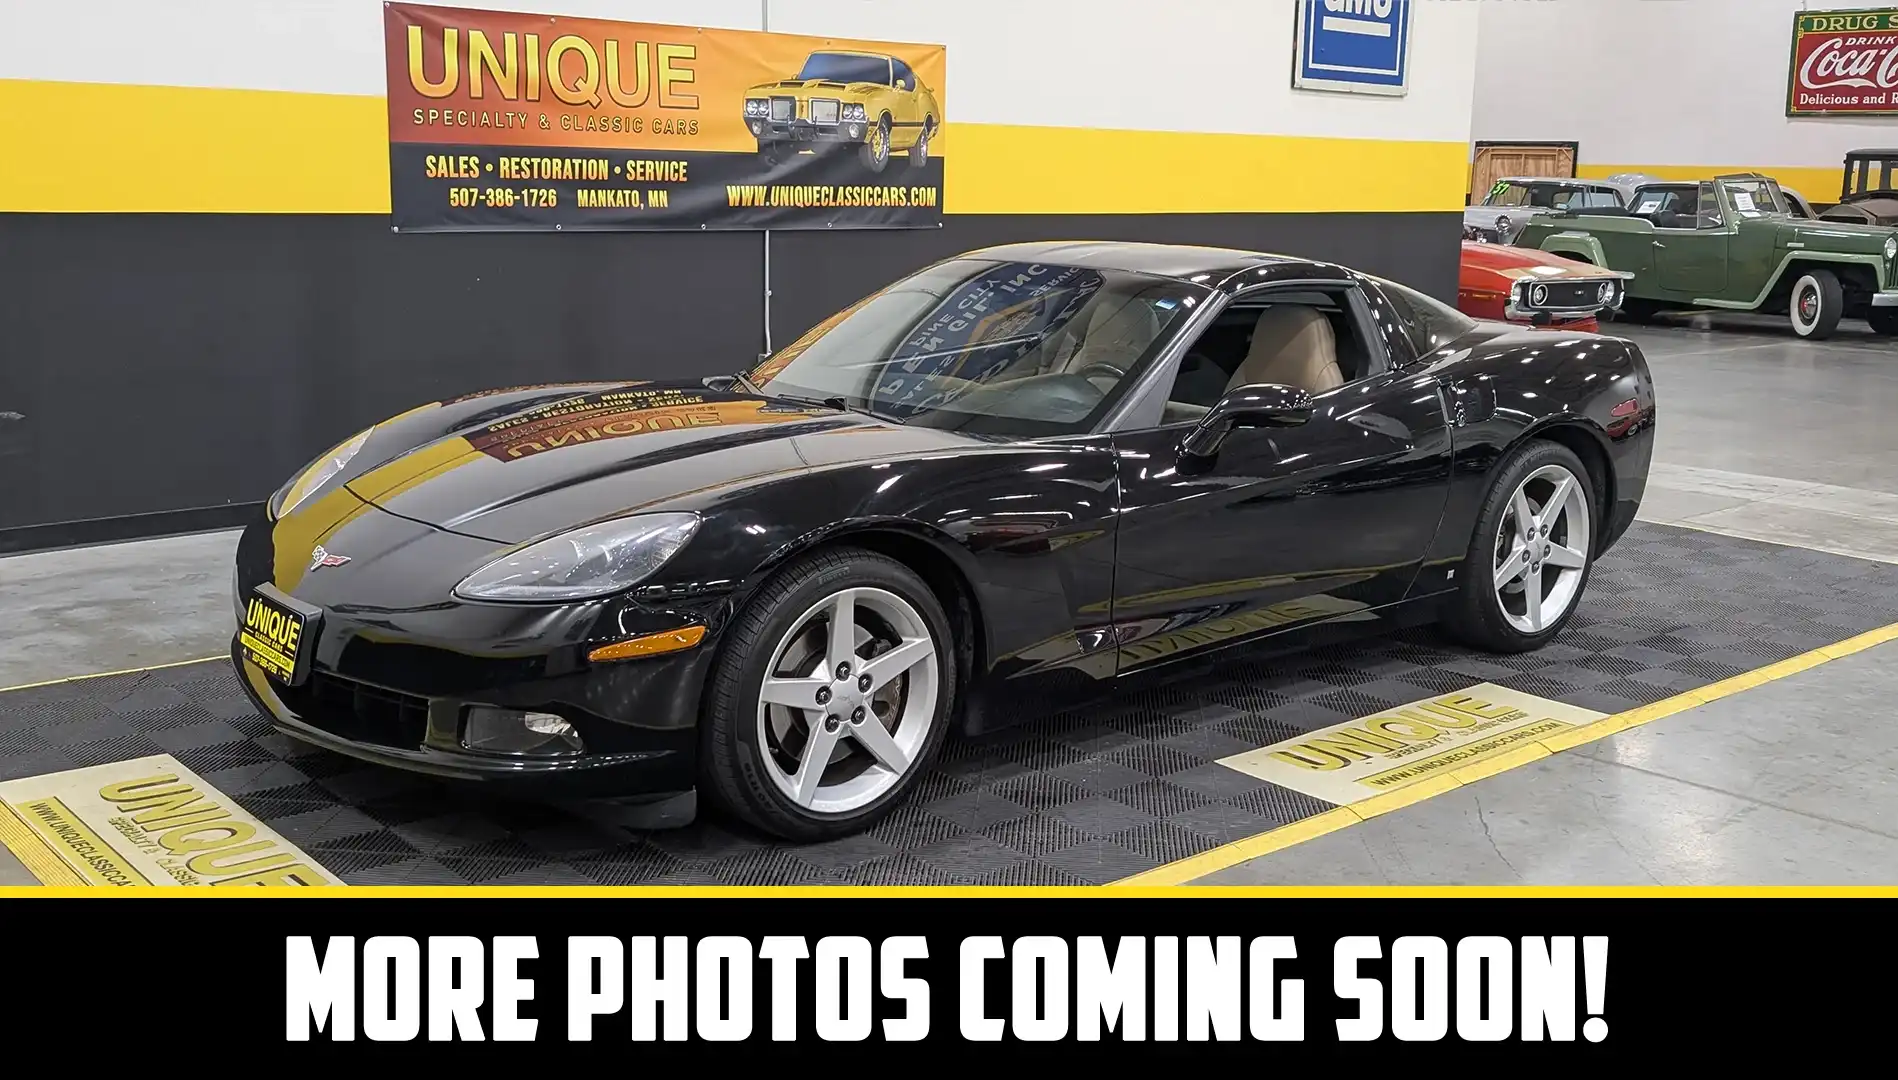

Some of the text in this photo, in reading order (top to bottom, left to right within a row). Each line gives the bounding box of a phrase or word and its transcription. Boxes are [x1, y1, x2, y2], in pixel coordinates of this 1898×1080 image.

[1812, 15, 1878, 31] DRUG
[1845, 36, 1897, 46] DRINK
[407, 24, 699, 110] UNIQUE
[1799, 93, 1859, 105] Delicious
[1863, 92, 1886, 105] and
[413, 108, 699, 136] SPECIALTY & CLASSIC CARS
[425, 154, 688, 182] SALES RESTORATION SERVICE
[449, 187, 668, 210] 507-386-1726 MANKATO, MN
[726, 185, 937, 208] WWW.UNIQUECLASSICCARS.COM
[246, 598, 300, 651] UNIQUE
[1268, 694, 1519, 771] UNIQUE
